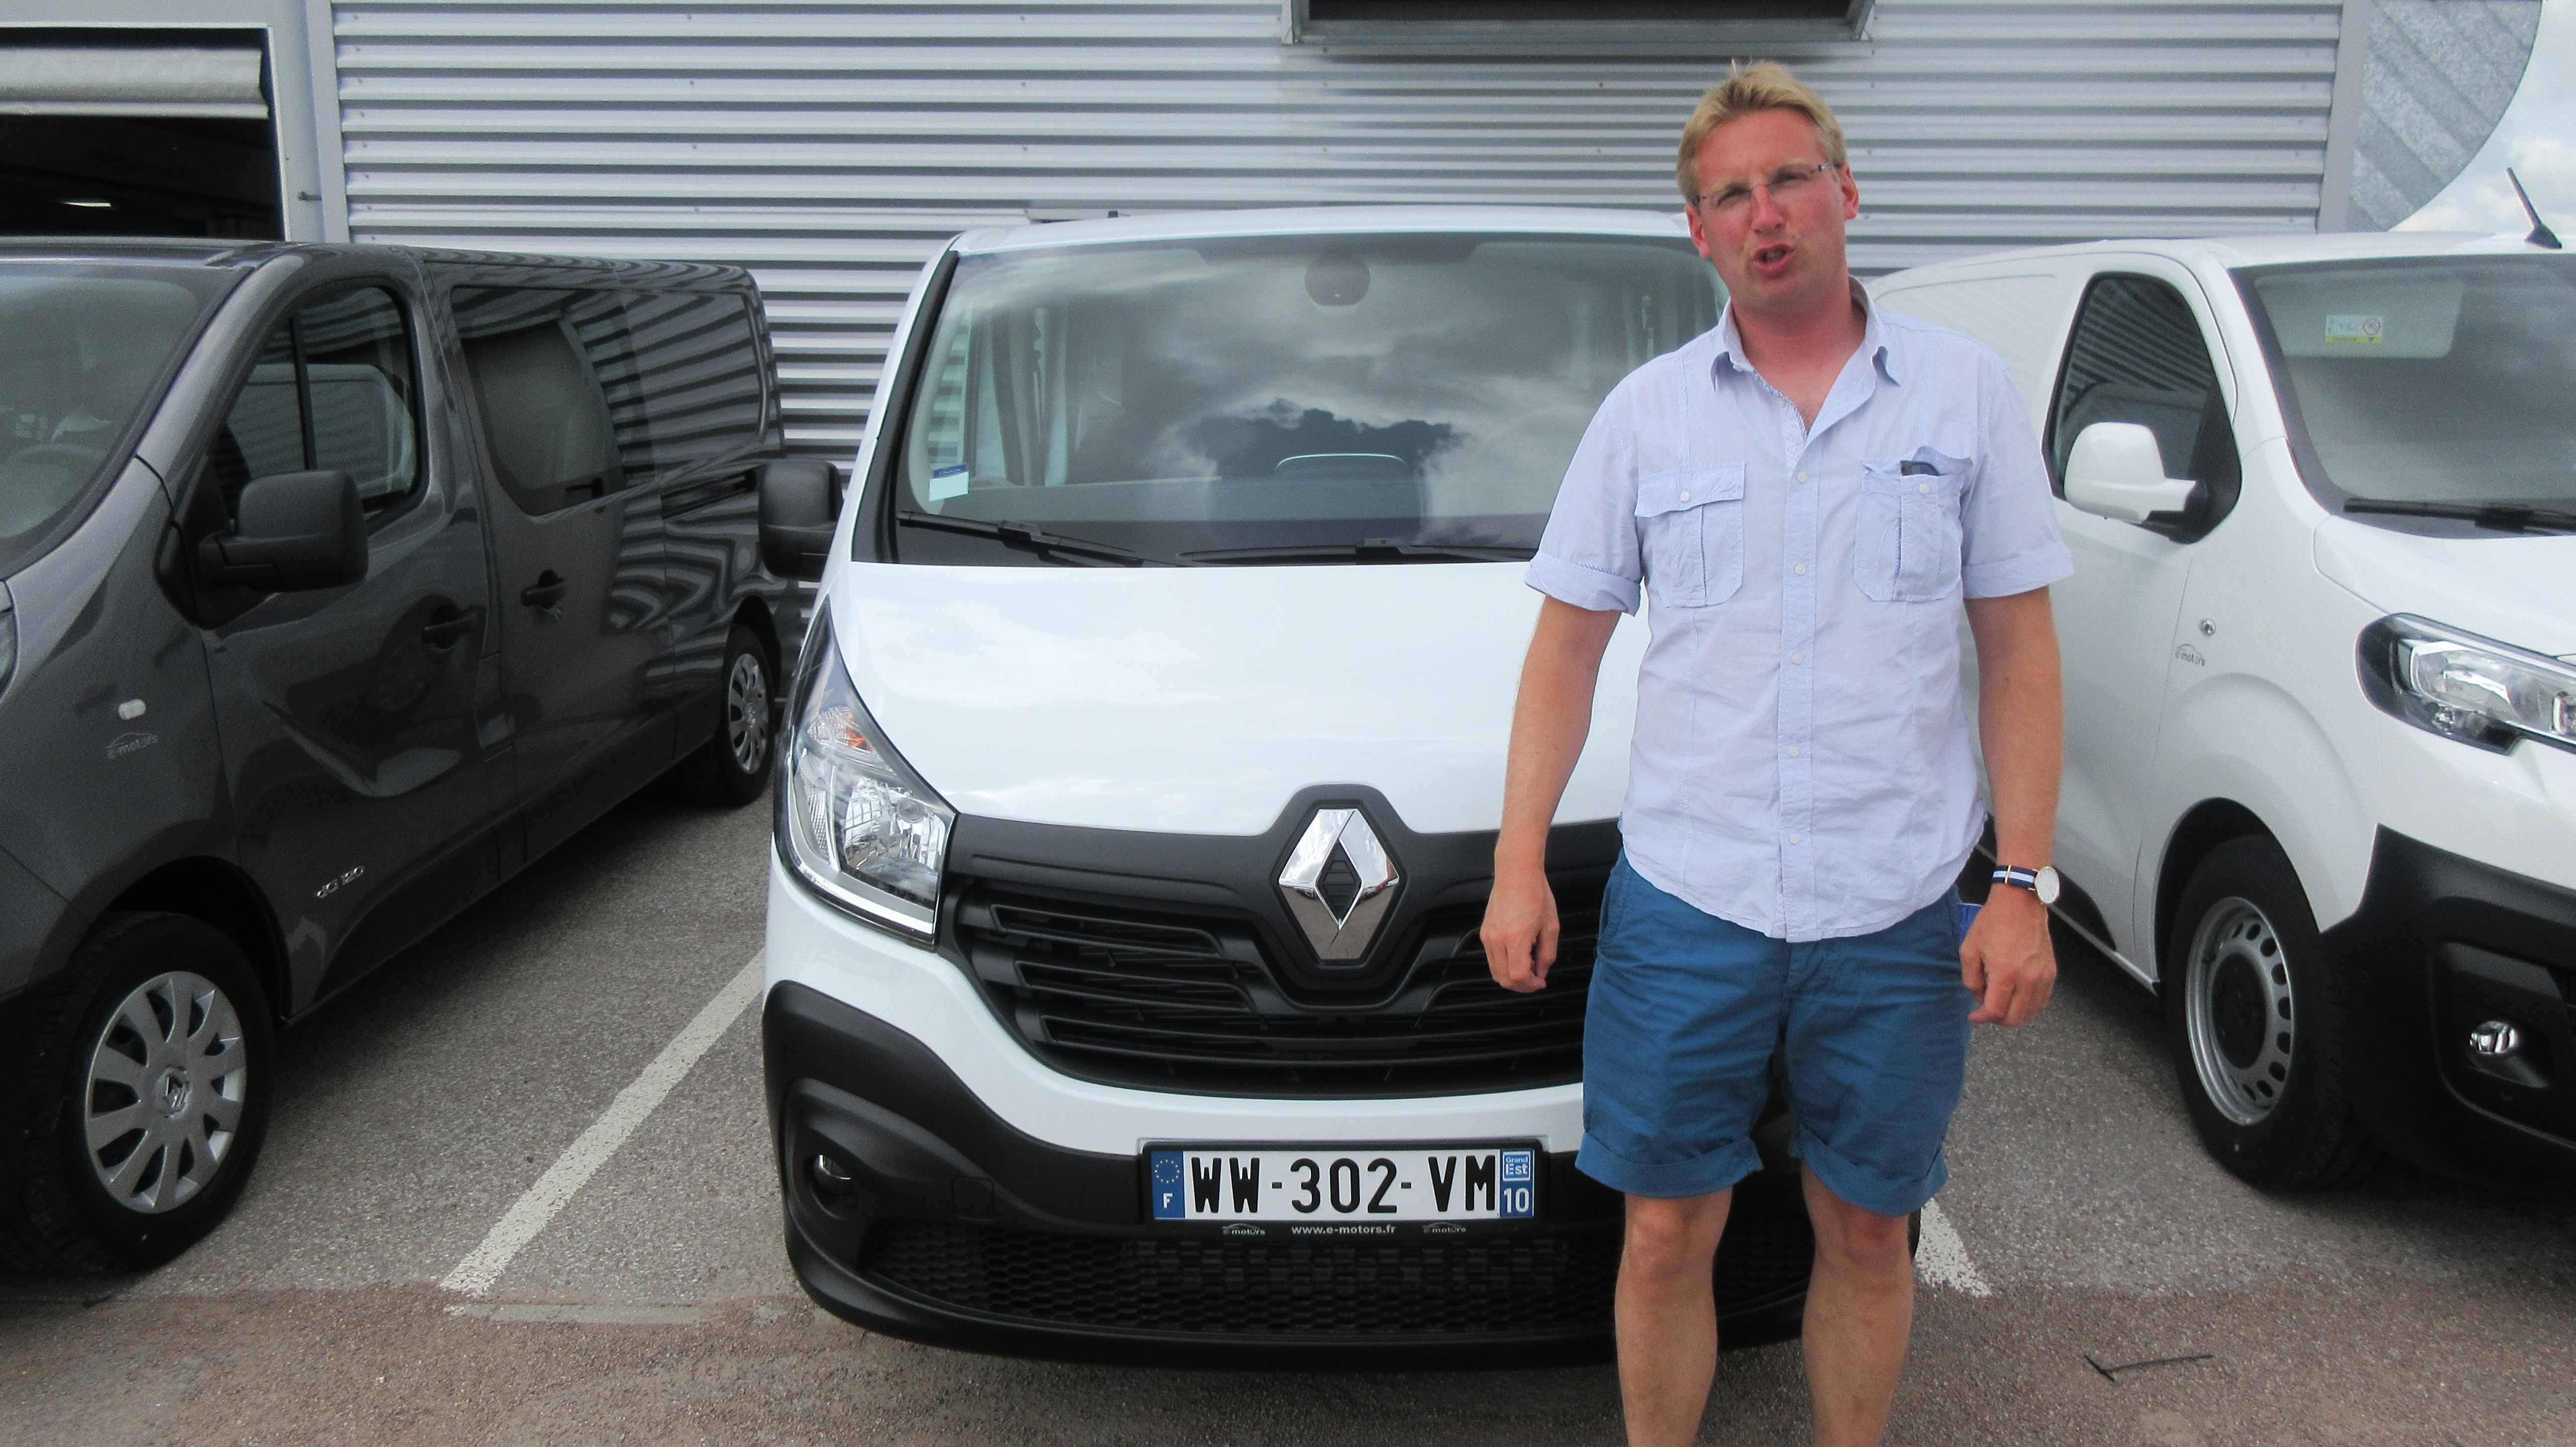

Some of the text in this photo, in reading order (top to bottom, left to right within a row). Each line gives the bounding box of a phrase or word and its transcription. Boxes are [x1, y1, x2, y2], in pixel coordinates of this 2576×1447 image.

[1505, 1163, 1528, 1175] Est
[1163, 1193, 1173, 1208] F
[1503, 1188, 1530, 1213] 10
[1291, 1224, 1396, 1234] www.e-motors.fr
